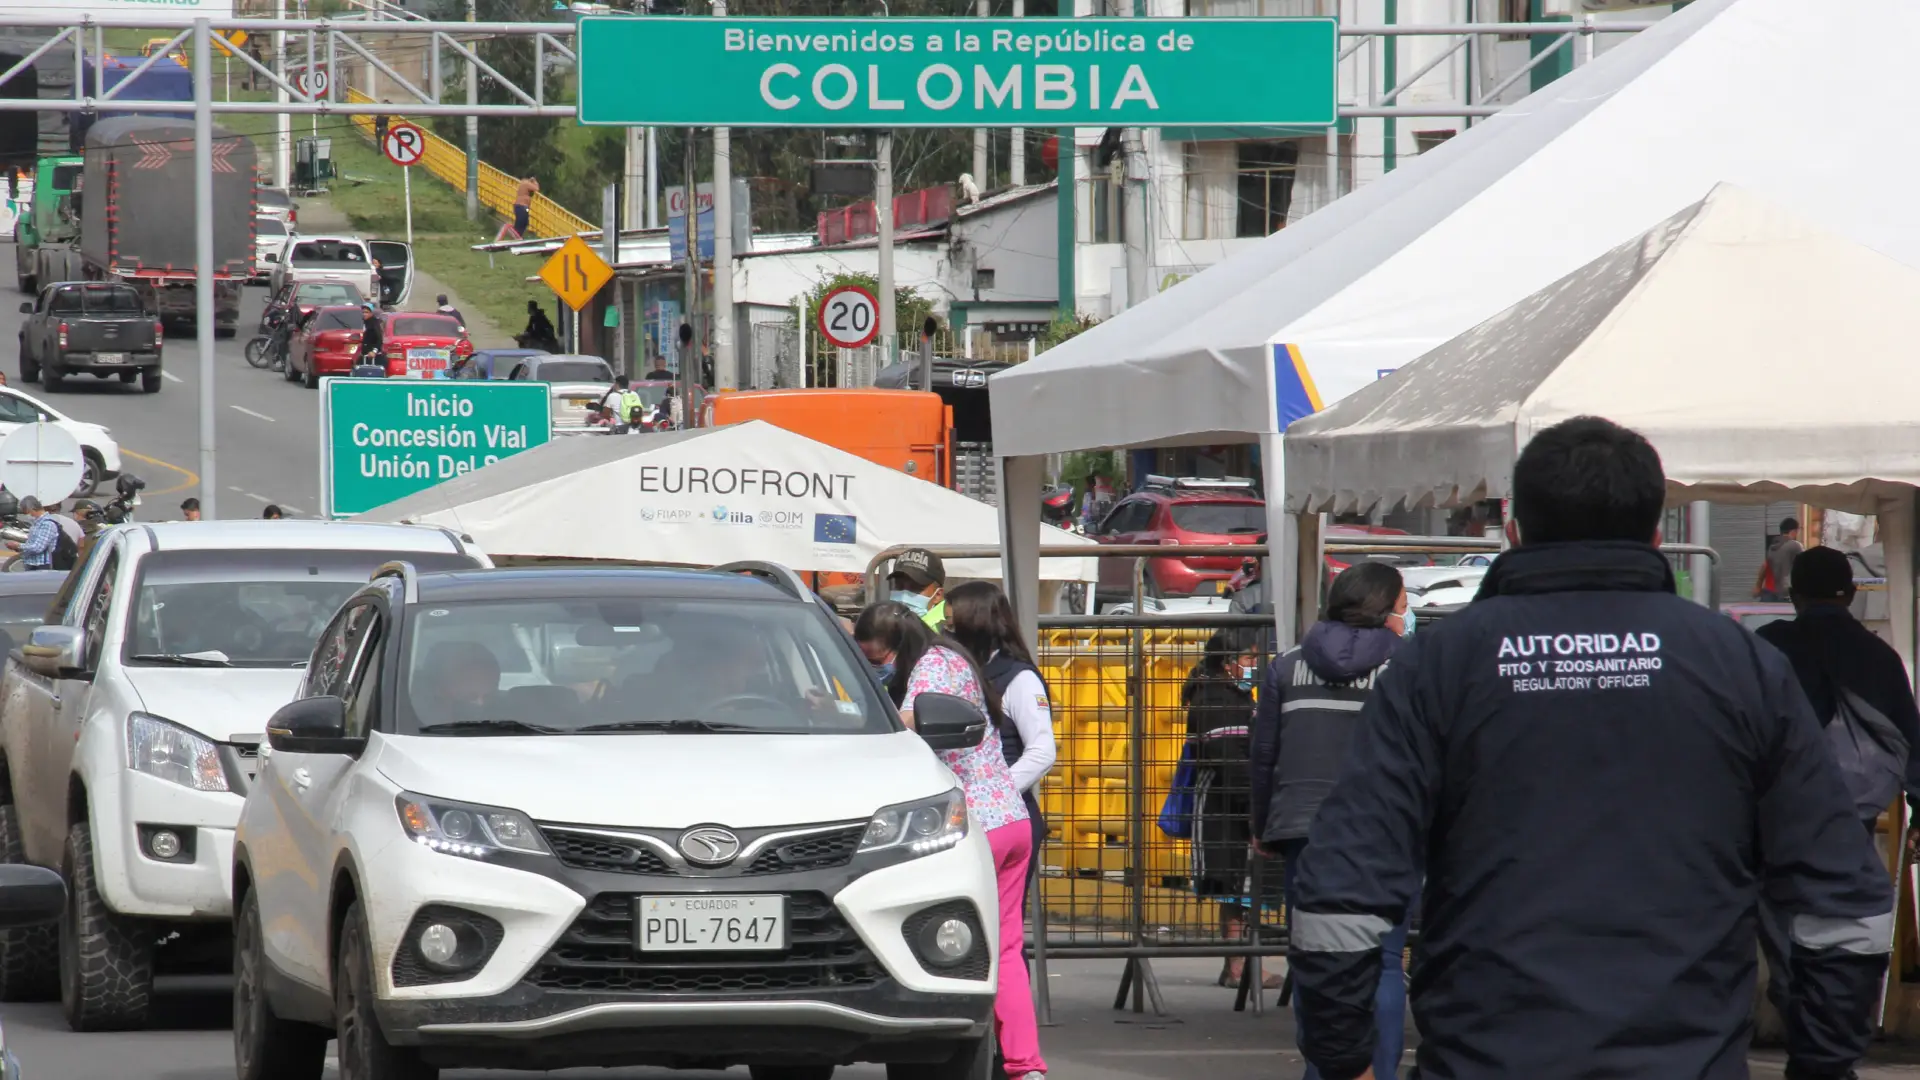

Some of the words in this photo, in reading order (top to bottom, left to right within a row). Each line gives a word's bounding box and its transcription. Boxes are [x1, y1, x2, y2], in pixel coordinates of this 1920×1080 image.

[724, 27, 915, 52] Bienvenidos
[926, 33, 943, 52] a
[954, 28, 981, 52] la
[991, 28, 1146, 59] República
[1156, 28, 1195, 52] de
[759, 62, 1160, 111] COLOMBIA
[830, 301, 870, 332] 20
[407, 392, 474, 417] Inicio
[352, 422, 477, 448] Concesión
[483, 424, 528, 449] Vial
[360, 453, 431, 479] Unión
[437, 454, 477, 479] Del
[640, 465, 857, 501] EUROFRONT
[656, 508, 692, 520] FIIAPP
[729, 511, 754, 525] iila
[774, 511, 804, 525] OIM
[1498, 632, 1661, 658] AUTORIDAD
[1498, 662, 1531, 677] FITO
[1537, 660, 1548, 673] Y
[1555, 657, 1663, 673] ZOOSANITARIO
[1512, 676, 1592, 693] REGULATORY
[1597, 674, 1650, 690] OFFICER
[685, 899, 738, 910] ECUADOR
[647, 917, 777, 944] PDL-7647
